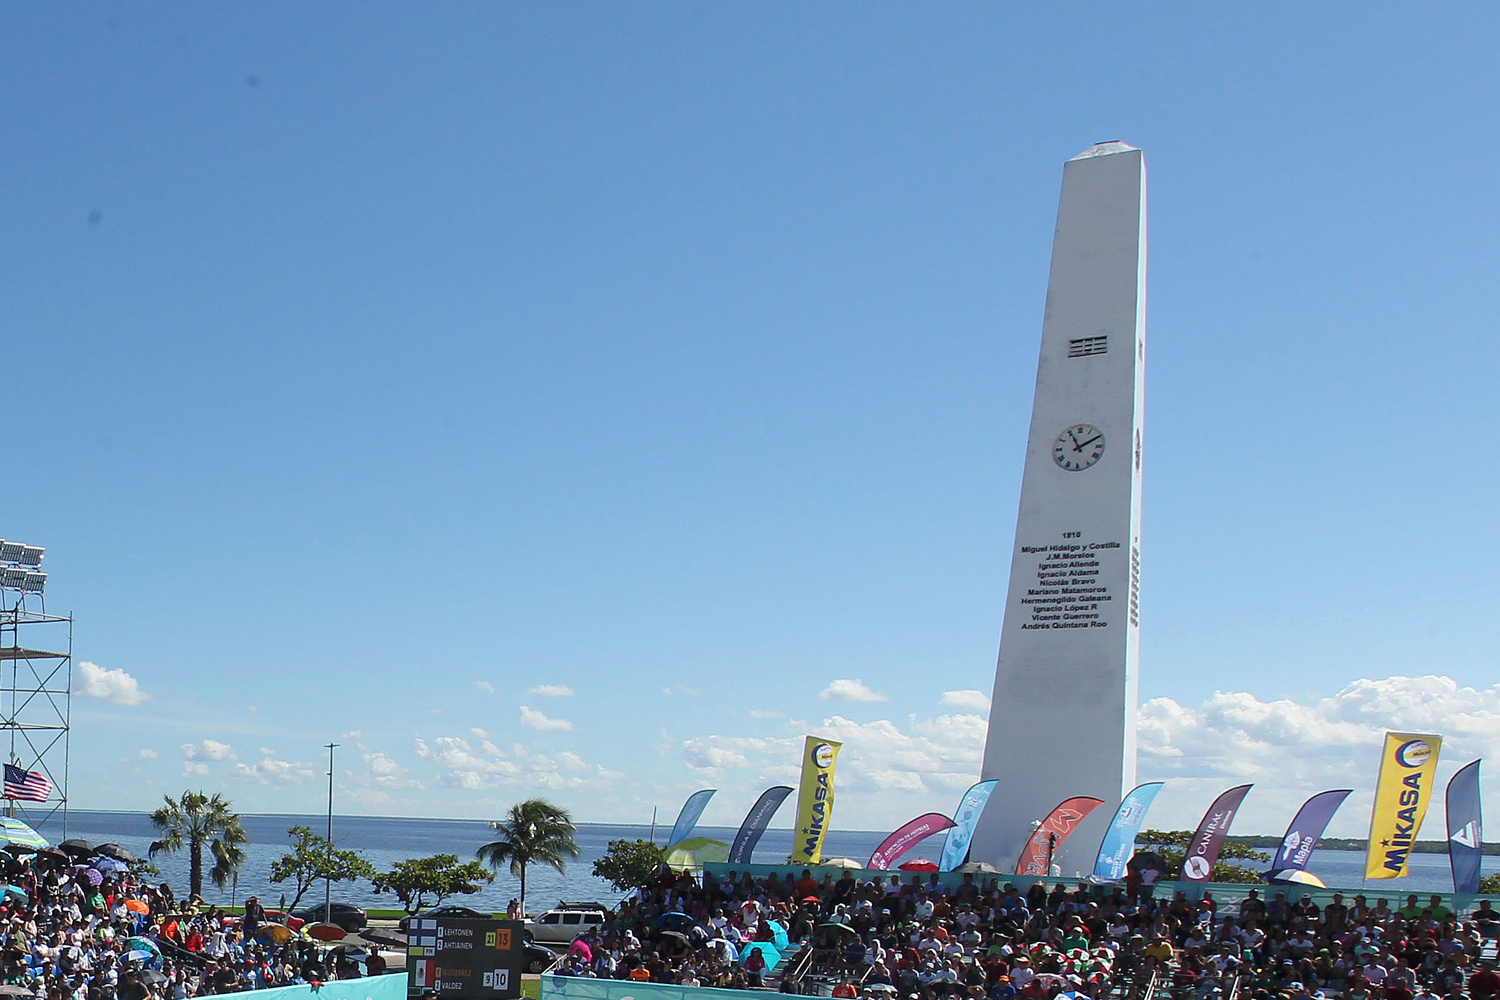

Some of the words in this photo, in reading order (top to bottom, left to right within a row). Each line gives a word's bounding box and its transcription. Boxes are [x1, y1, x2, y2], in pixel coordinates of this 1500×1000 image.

[1061, 531, 1082, 539] 1810
[1021, 546, 1048, 554] Miguel
[1049, 544, 1080, 553] Hidalgo
[1089, 541, 1121, 550] Costilla
[1038, 562, 1068, 571] Ignacio
[1069, 560, 1100, 568] Allende
[1037, 571, 1067, 579] Ignacio
[1069, 569, 1099, 577] Aldama
[1039, 578, 1069, 587] Nicolás
[1027, 588, 1059, 596] Mariano
[1061, 586, 1107, 594] Matamoros
[1021, 596, 1076, 605] Hermenegildo
[1078, 594, 1112, 602] Galeana
[1033, 605, 1063, 614] Ignacio
[1064, 603, 1089, 612] López
[1031, 613, 1061, 621] Vicente
[1062, 612, 1099, 620] Guerrero
[1021, 622, 1050, 630] Andrés
[1051, 621, 1089, 630] Quintana
[1090, 620, 1108, 628] Roo
[802, 772, 829, 857] MIKASA
[1382, 771, 1423, 873] MIKASA
[1197, 811, 1224, 855] CANIRAC
[1292, 835, 1314, 865] Mapla
[444, 928, 474, 937] LEHTONEN
[486, 934, 495, 944] 21
[495, 972, 506, 986] 10
[441, 981, 463, 990] VALDEZ
